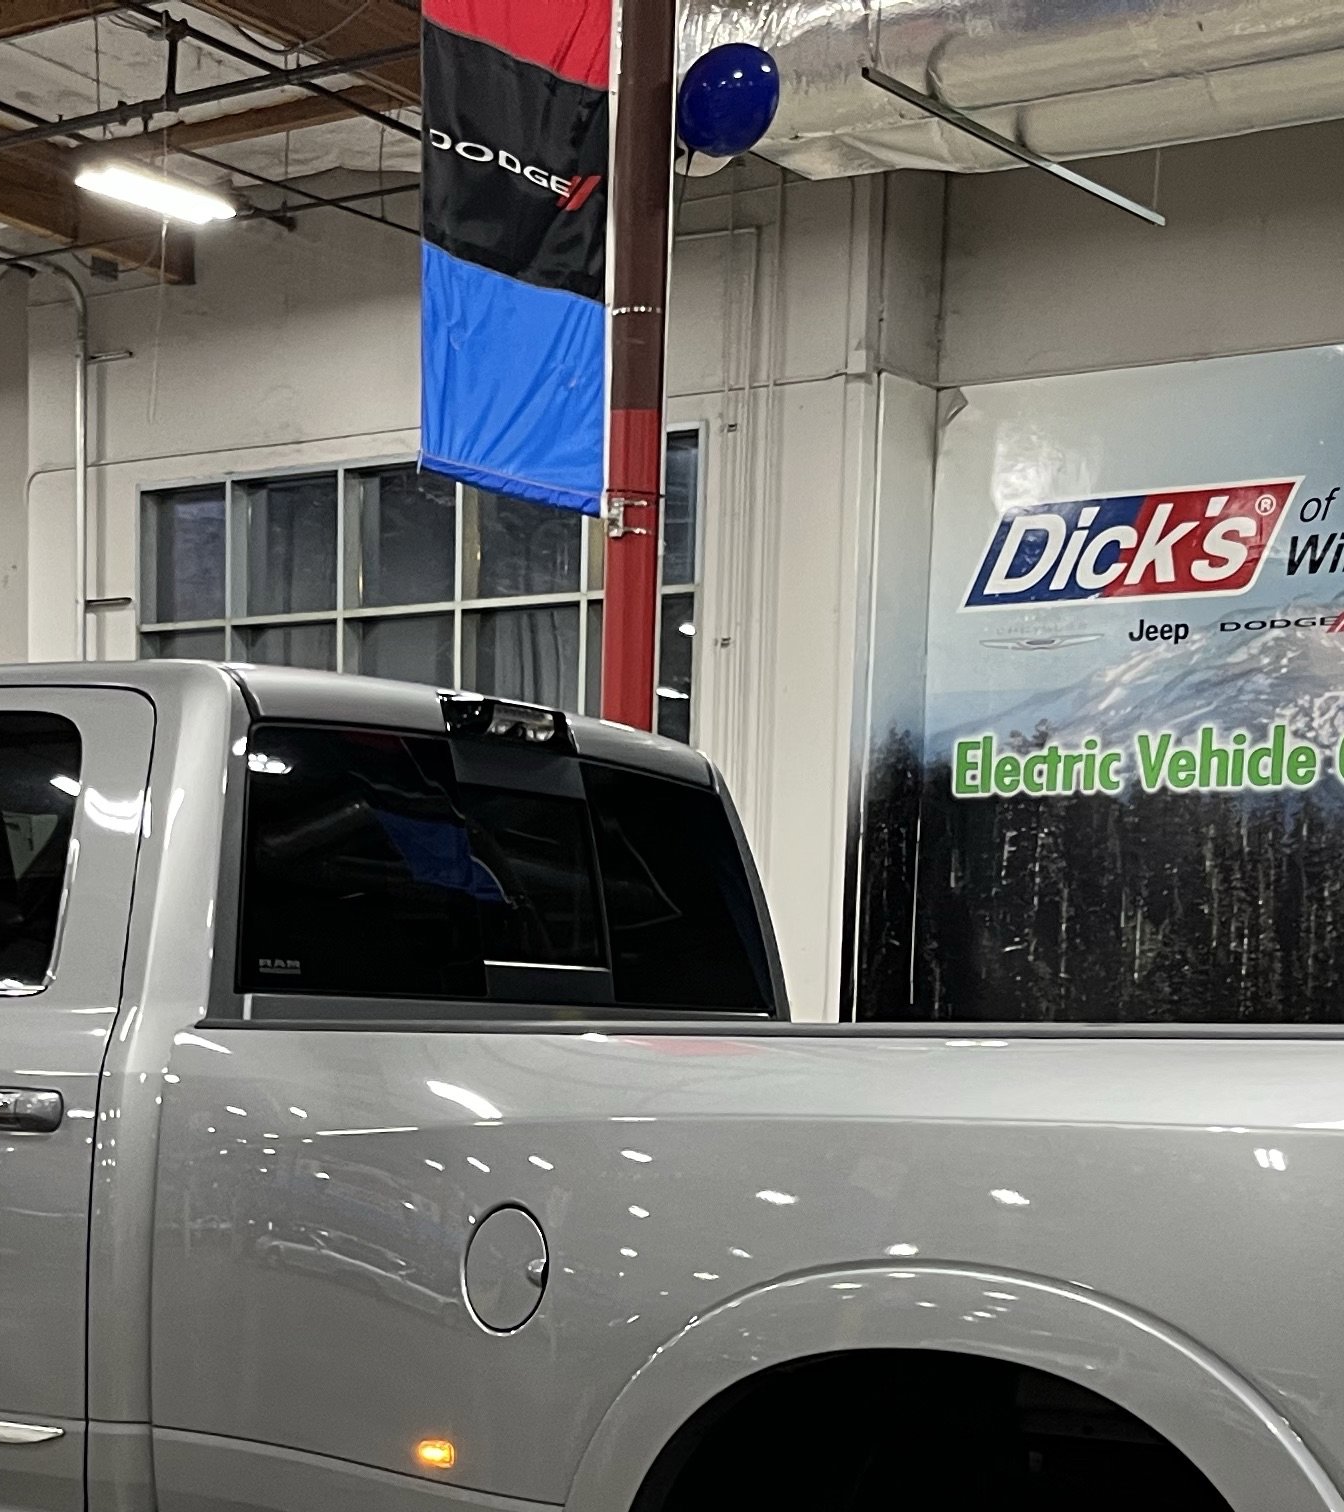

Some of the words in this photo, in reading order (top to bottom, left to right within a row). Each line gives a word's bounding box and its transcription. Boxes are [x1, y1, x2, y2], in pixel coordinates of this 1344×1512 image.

[429, 128, 573, 198] DODGE
[983, 496, 1256, 596] Dick's
[1299, 487, 1341, 523] of
[1128, 619, 1189, 644] Jeep
[1219, 615, 1339, 632] DODGE
[955, 735, 1121, 794] Electric
[1137, 725, 1317, 789] Vehicle
